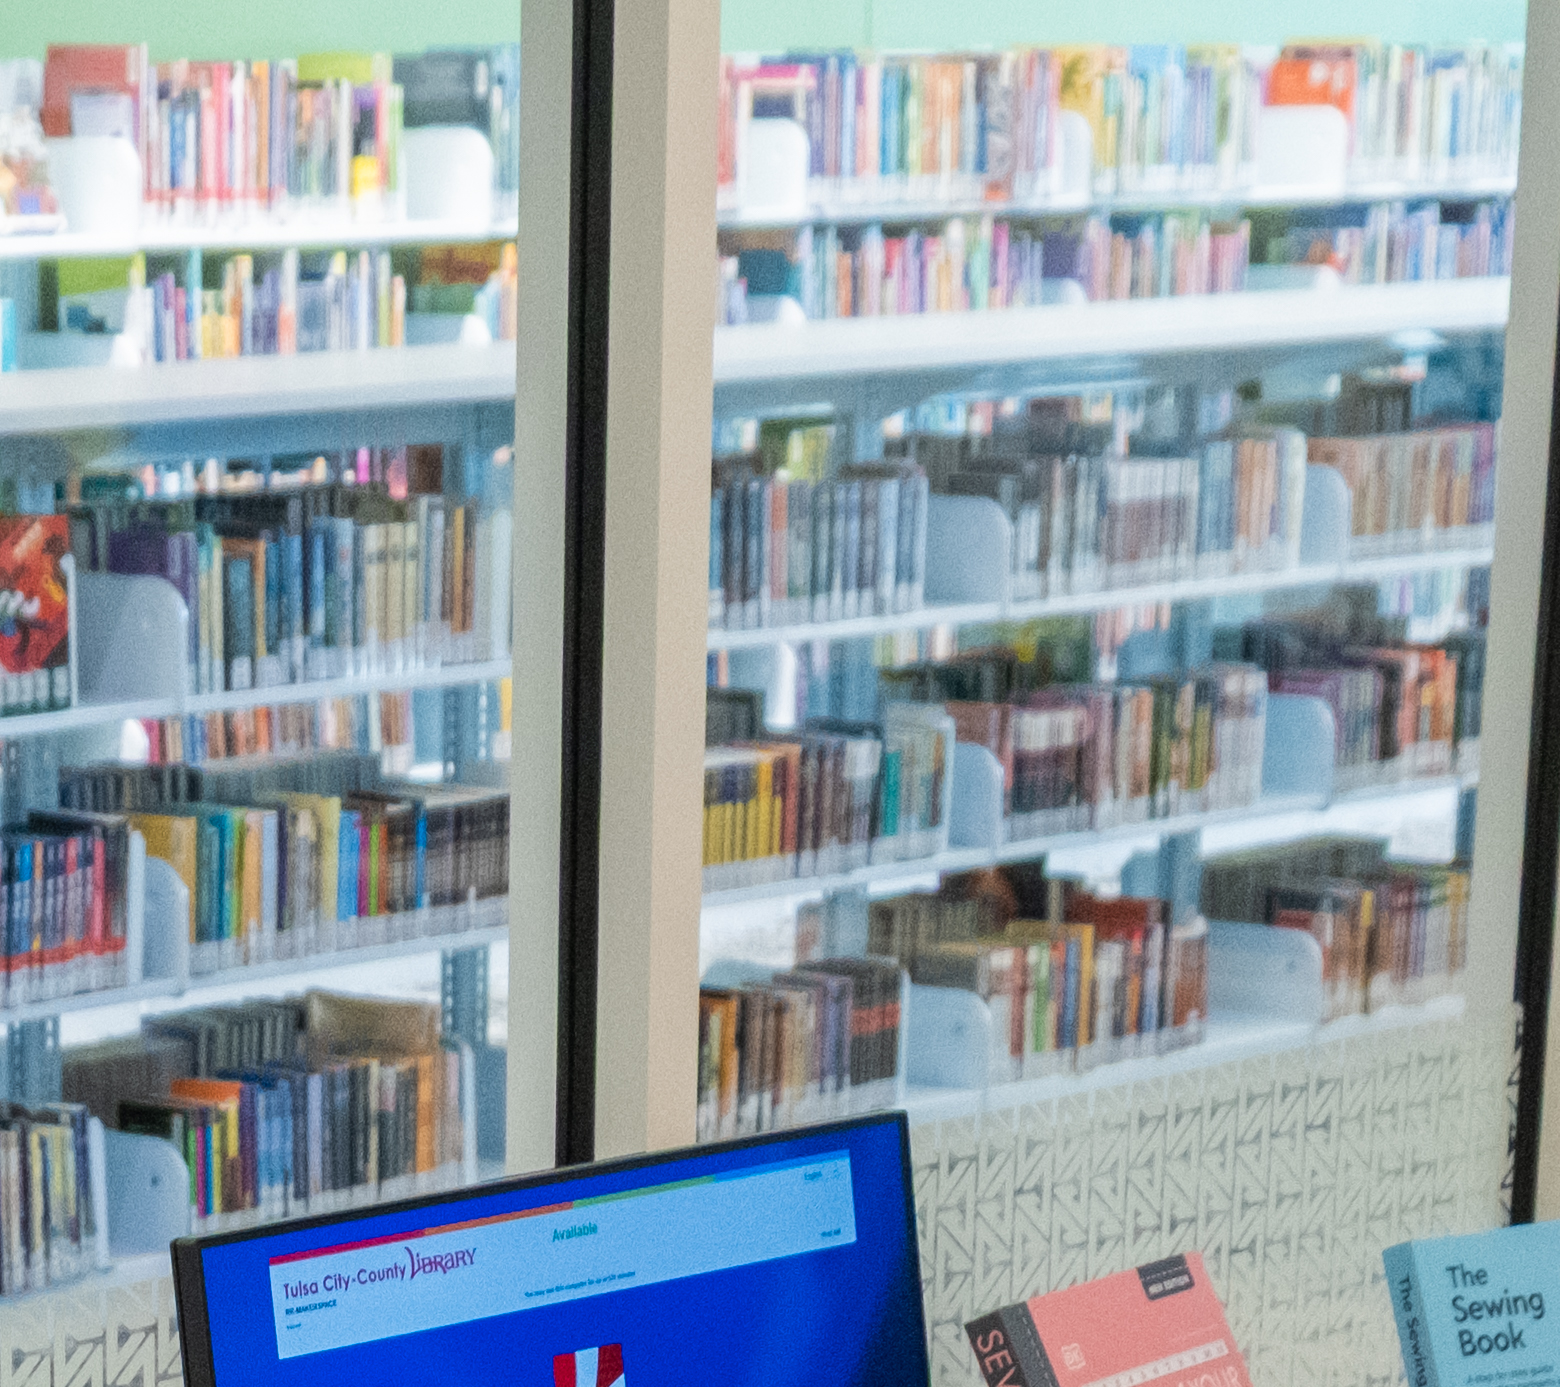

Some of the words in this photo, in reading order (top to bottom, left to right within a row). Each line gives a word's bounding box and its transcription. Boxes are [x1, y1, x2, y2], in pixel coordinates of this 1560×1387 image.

[552, 1222, 598, 1243] Available
[283, 1280, 319, 1300] Tulsa
[322, 1262, 406, 1292] City-County
[1445, 1263, 1489, 1288] The
[1451, 1288, 1546, 1323] Sewing
[1398, 1274, 1413, 1313] The
[1407, 1316, 1428, 1387] Sewing
[1458, 1321, 1527, 1356] Book
